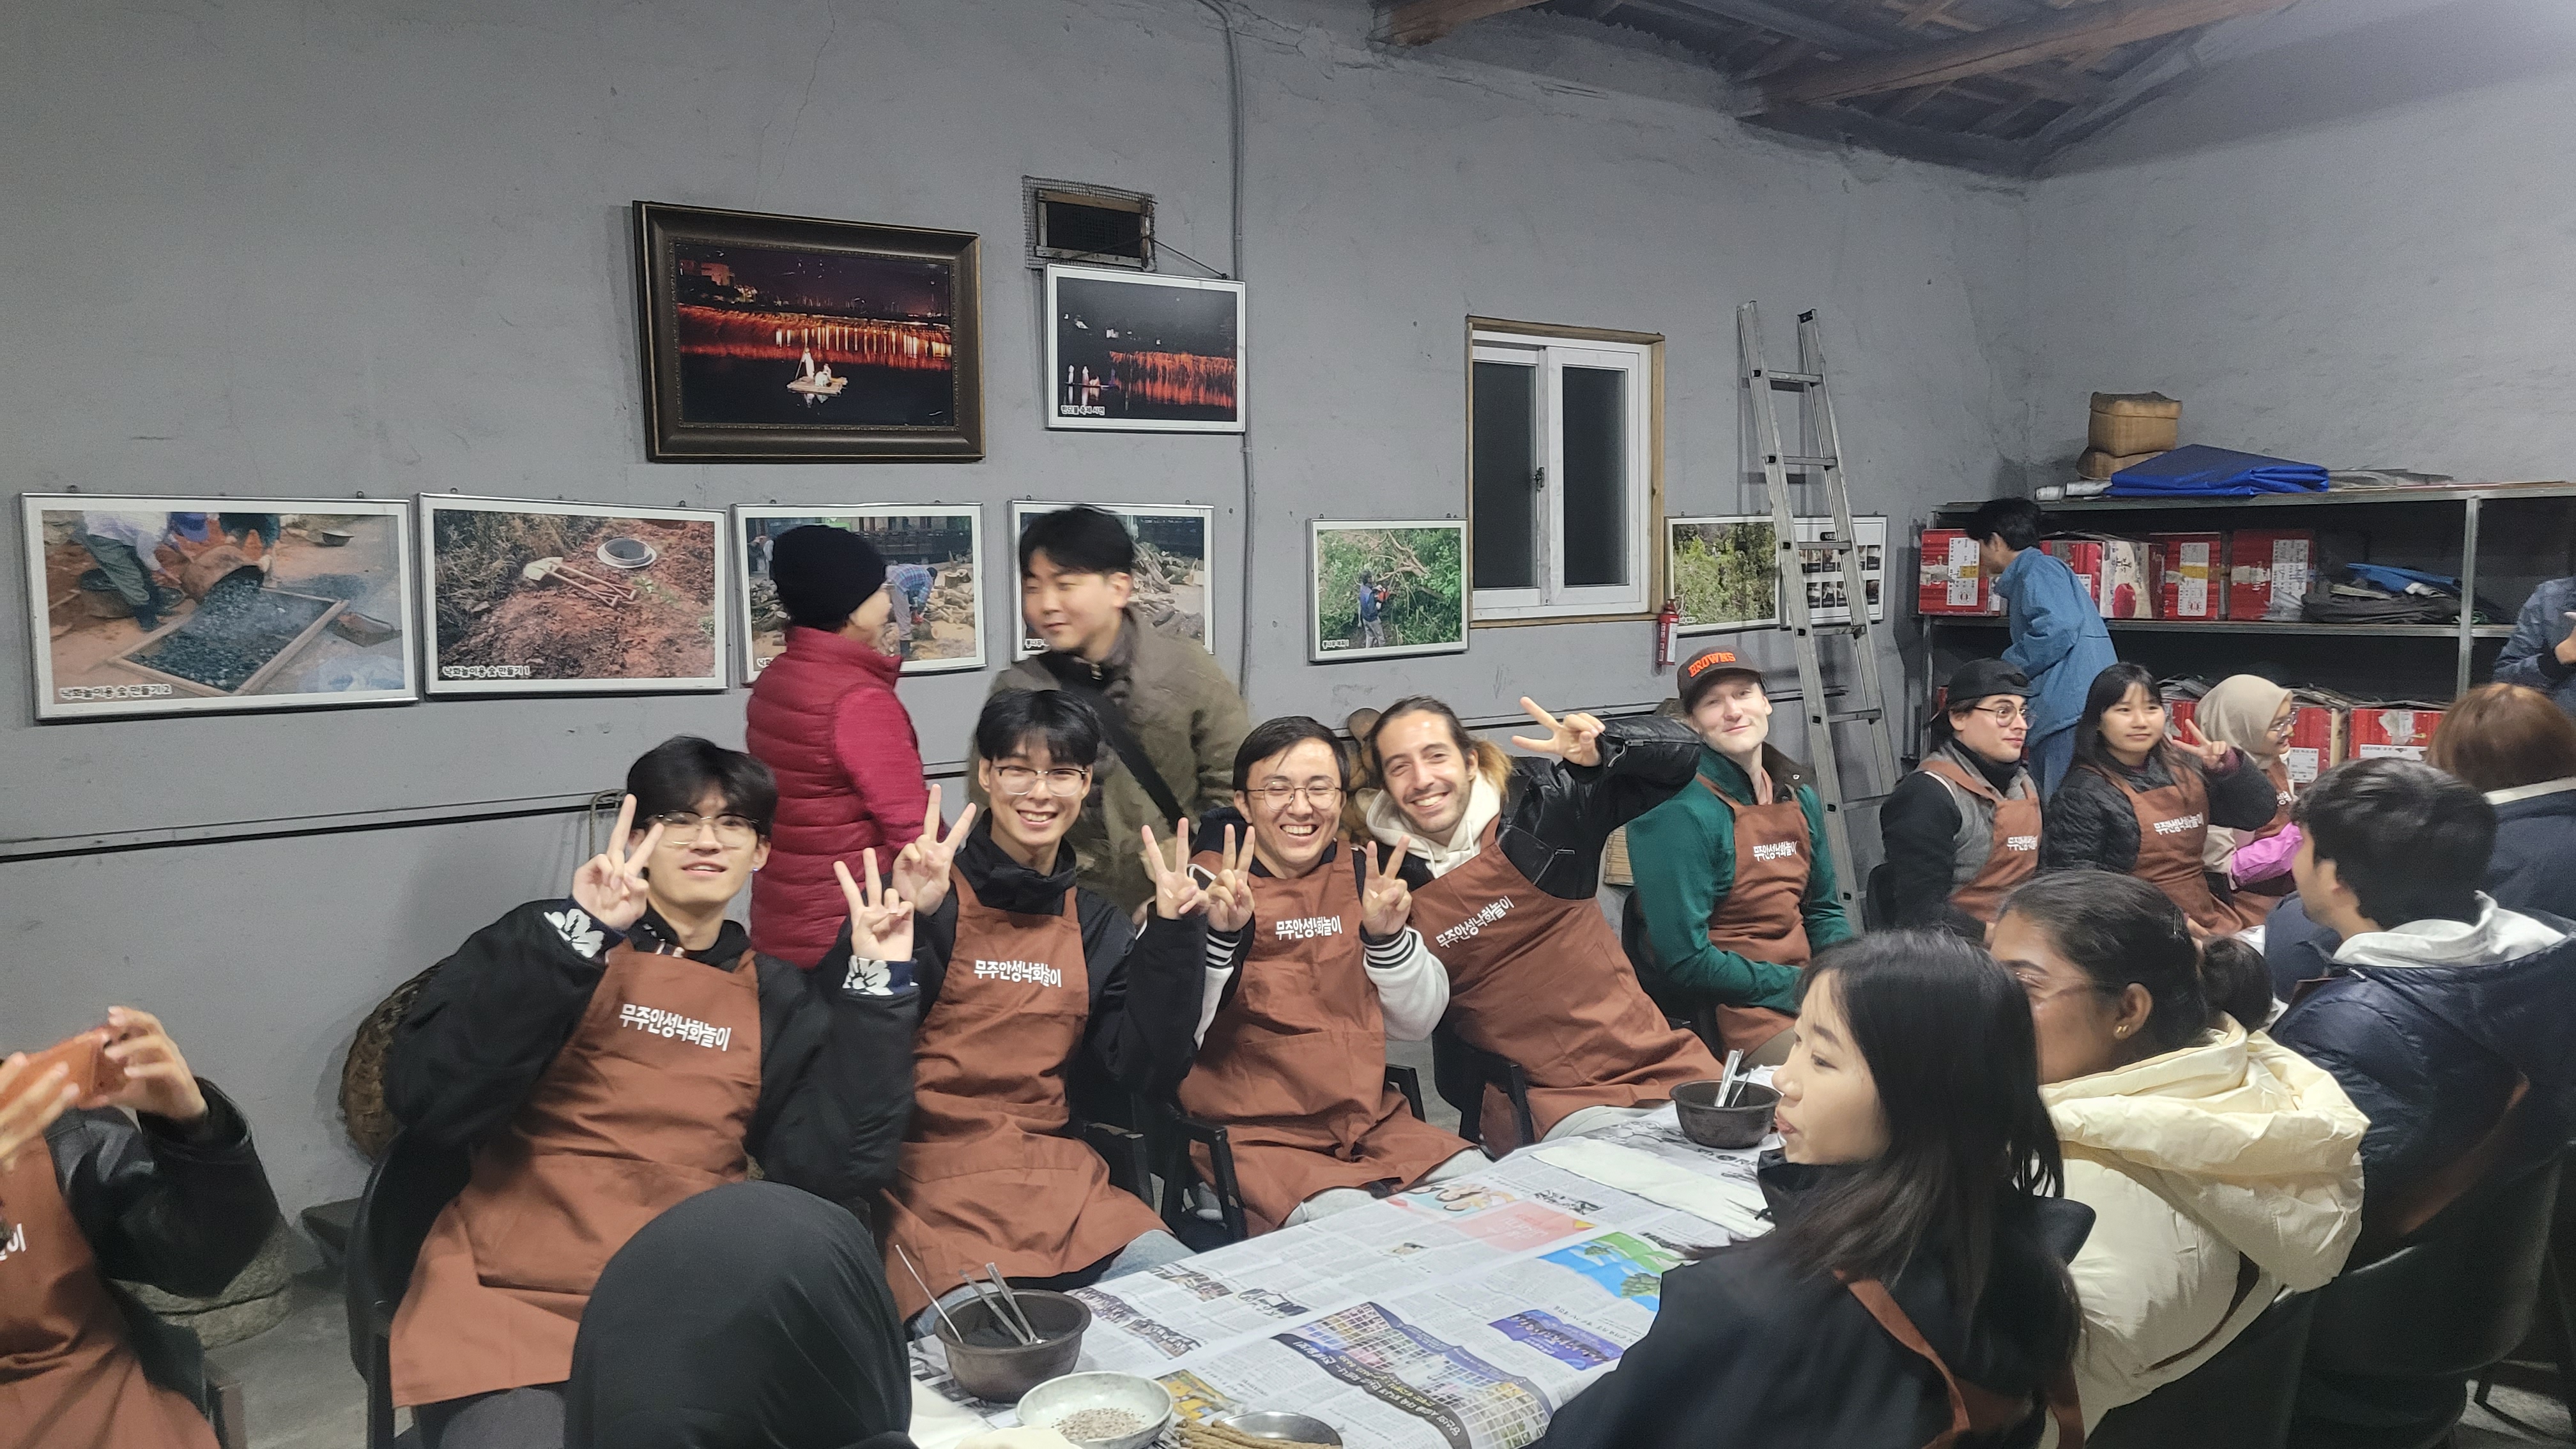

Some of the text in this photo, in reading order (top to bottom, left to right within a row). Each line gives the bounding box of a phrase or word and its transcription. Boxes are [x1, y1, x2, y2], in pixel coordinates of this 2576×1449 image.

[1688, 652, 1736, 678] BROWNS
[1753, 840, 1798, 862] 무주안성낙화놀이
[1436, 895, 1515, 948] 무주안성낙화놀이
[974, 960, 1062, 988] 무주안성낙화놀이
[619, 1004, 732, 1052] 무주안성낙화놀이
